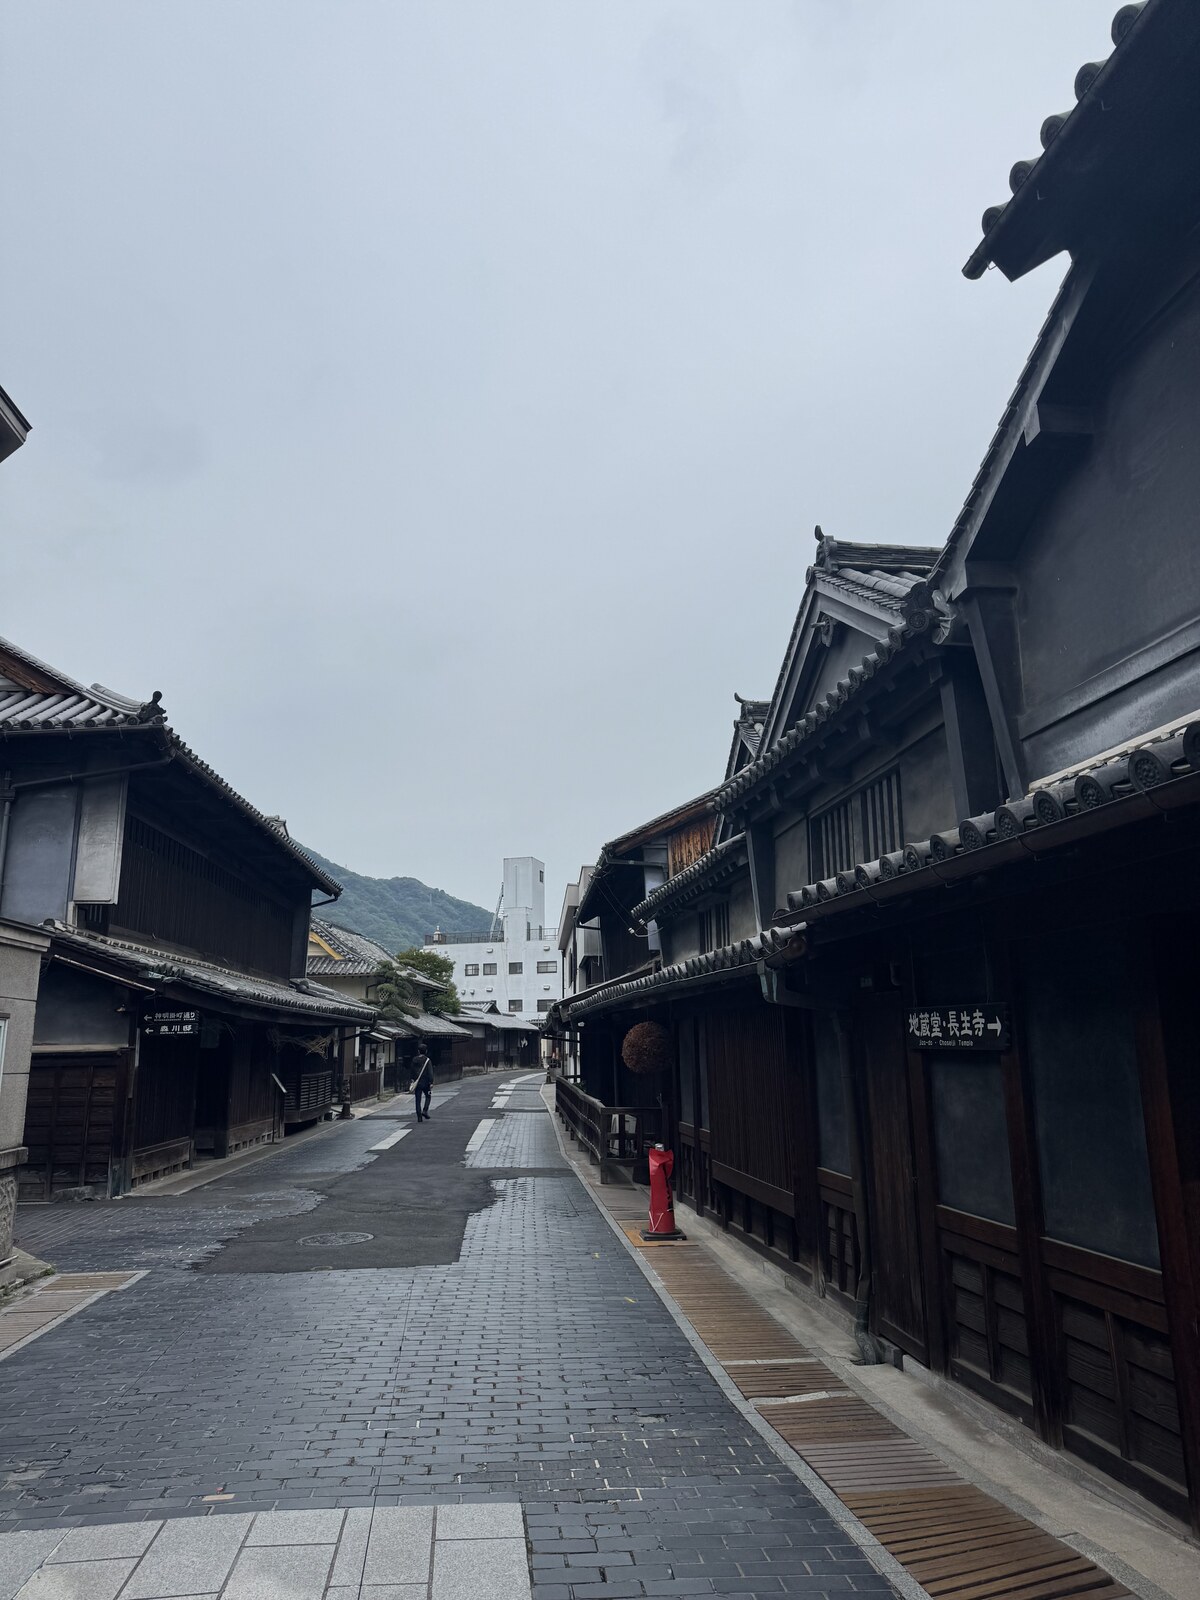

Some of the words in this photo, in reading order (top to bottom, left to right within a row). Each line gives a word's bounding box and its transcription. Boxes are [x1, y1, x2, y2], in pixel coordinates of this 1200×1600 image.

[908, 1008, 986, 1038] 地蔵堂・長生寺
